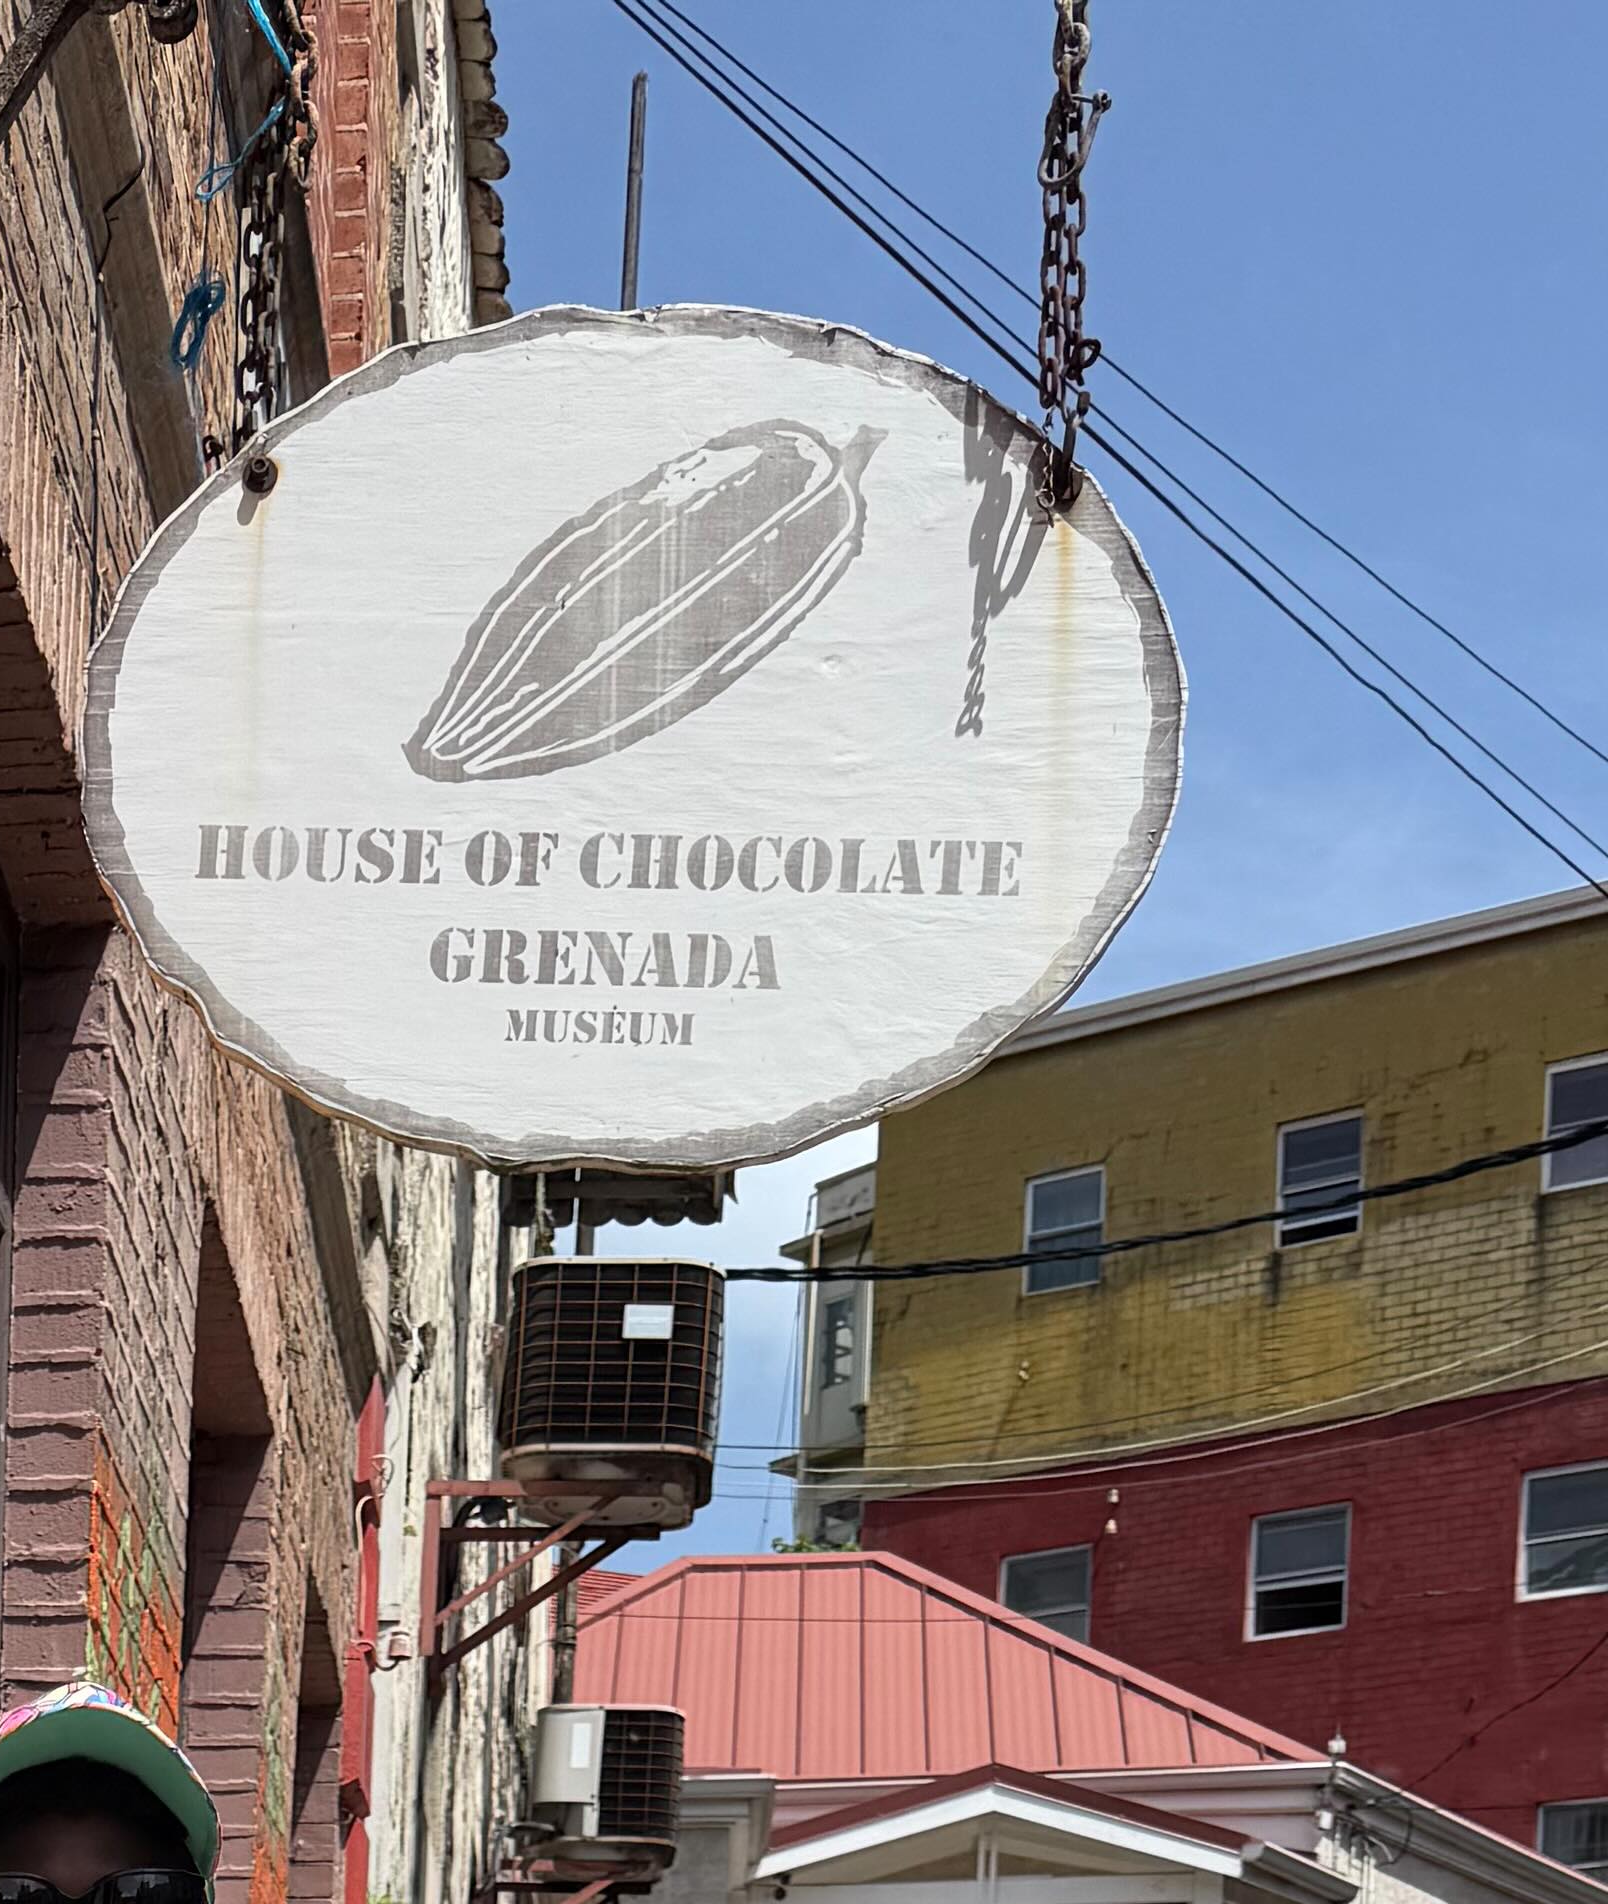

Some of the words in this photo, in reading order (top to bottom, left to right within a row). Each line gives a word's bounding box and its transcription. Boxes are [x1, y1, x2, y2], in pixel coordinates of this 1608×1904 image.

[195, 824, 443, 885] HOUSE
[465, 829, 560, 887] OF
[579, 831, 1024, 897] CHOCOLATE
[429, 927, 781, 989] GRENADA
[504, 1008, 695, 1046] MUSEUM
